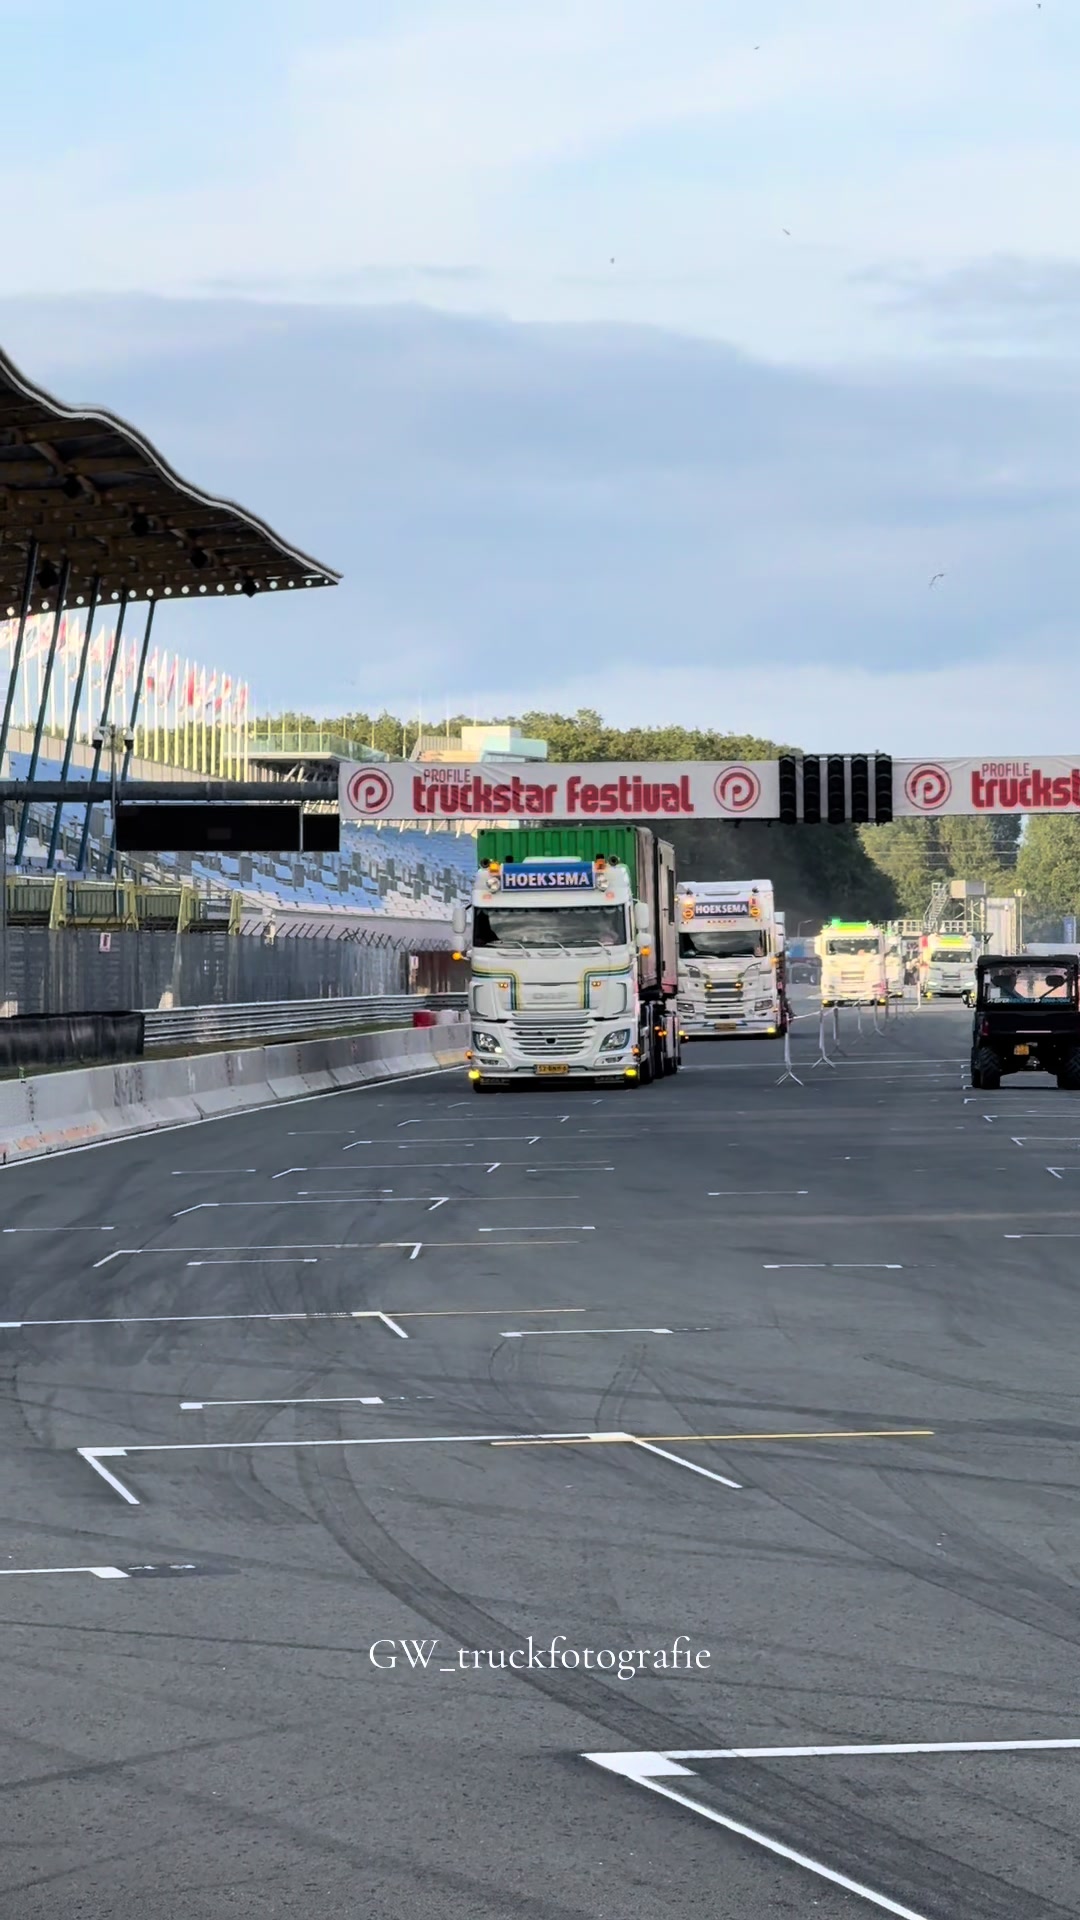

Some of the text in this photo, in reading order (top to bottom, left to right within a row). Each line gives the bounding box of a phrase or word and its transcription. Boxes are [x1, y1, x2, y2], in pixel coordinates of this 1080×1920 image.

[423, 768, 471, 782] PROFILE
[981, 762, 1030, 777] PROFILE
[412, 774, 695, 814] truckstar festival
[505, 872, 590, 887] HOEKSEMA
[695, 904, 748, 914] HOEKSEMA
